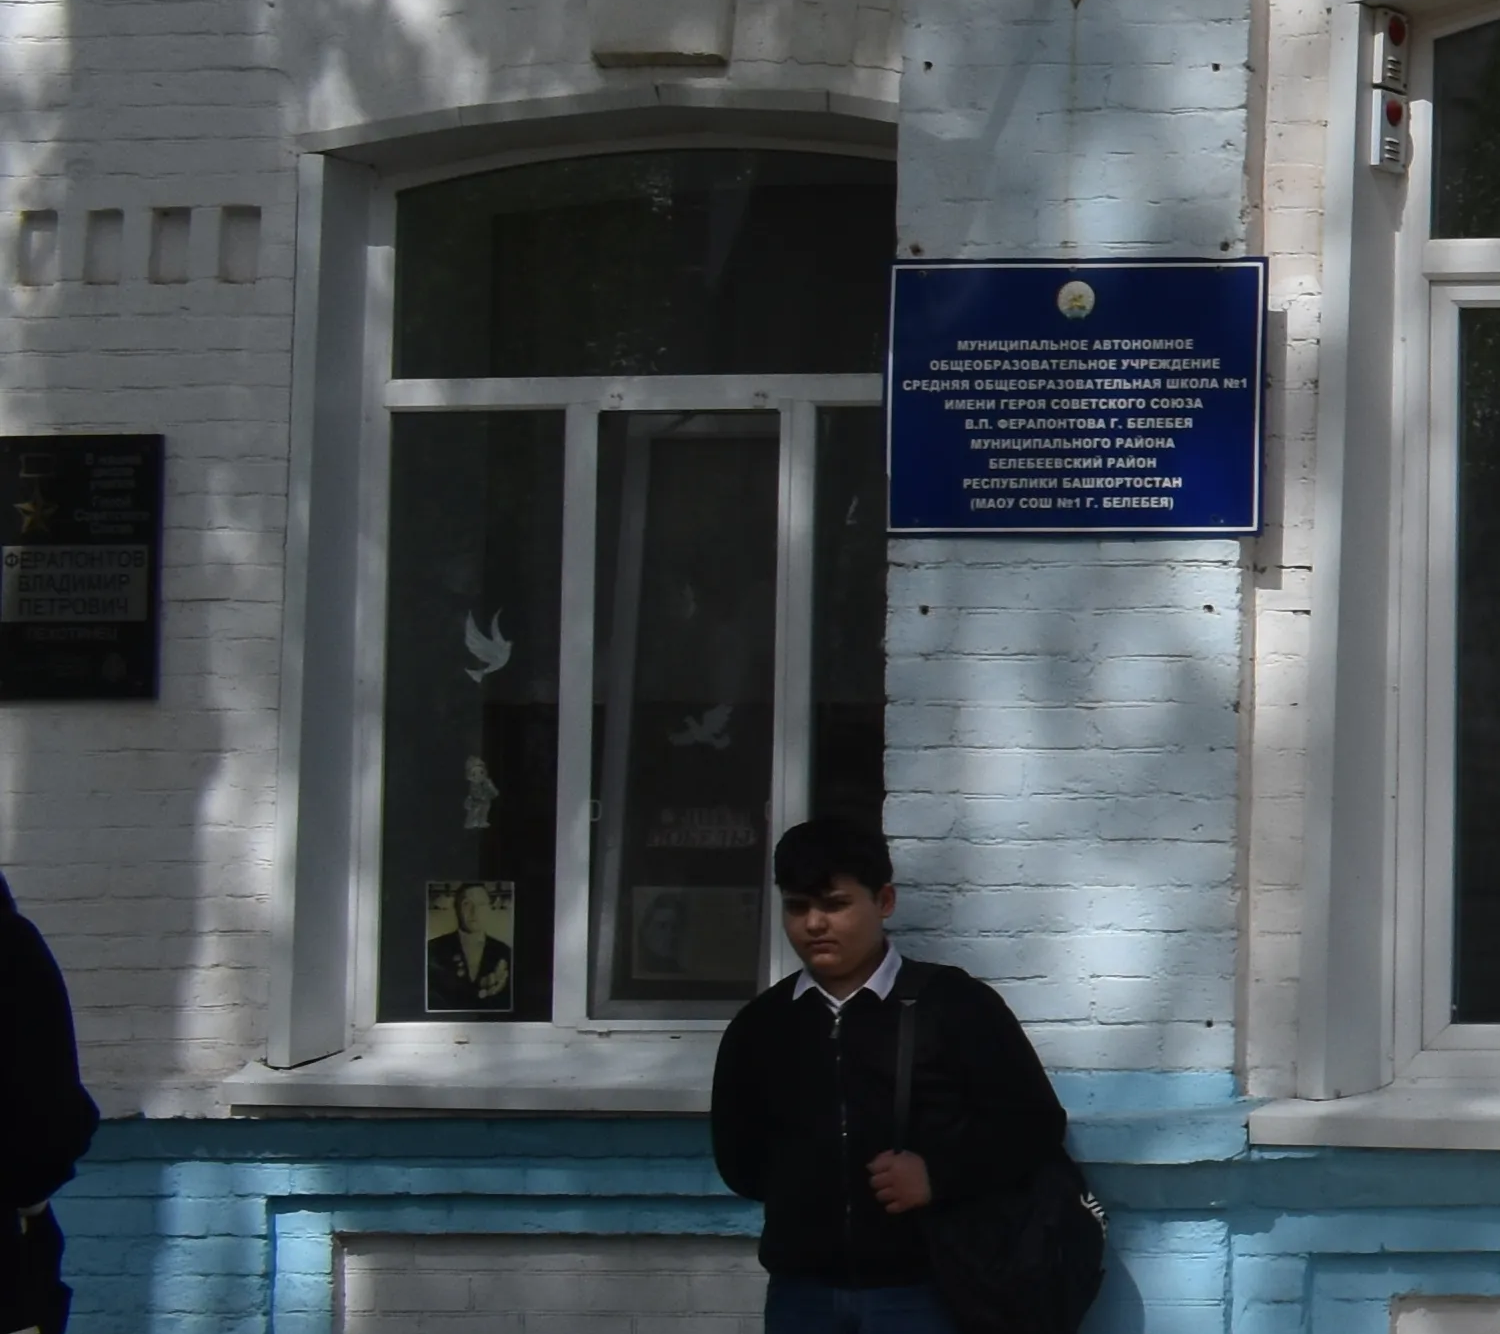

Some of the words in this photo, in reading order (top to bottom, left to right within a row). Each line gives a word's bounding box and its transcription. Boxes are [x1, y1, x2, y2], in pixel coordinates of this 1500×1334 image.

[957, 340, 1088, 351] МУНИЦИПАЛЬНОЕ
[1093, 339, 1193, 350] АВТОНОМНОЕ
[930, 359, 1117, 371] ОБЩЕОБРАЗОВАТЕЛЬНОЕ
[1122, 359, 1220, 370] УЧРЕЖДЕНИЕ
[903, 379, 969, 392] СРЕДНЯЯ
[974, 379, 1161, 391] ОБЩЕОБРАЗОВАТЕЛЬНАЯ
[1166, 379, 1219, 389] ШКОЛА
[1224, 379, 1247, 389] №1
[944, 399, 996, 410] ИМЕНИ
[1001, 399, 1046, 410] ГЕРОЯ
[1051, 399, 1146, 409] СОВЕТСКОГО
[1151, 398, 1202, 409] СОЮЗА
[965, 419, 992, 429] В.П.
[998, 419, 1105, 429] ФЕРАПОНТОВА
[1110, 419, 1122, 429] Г.
[1127, 418, 1192, 429] БЕЛЕБЕЯ
[971, 438, 1111, 450] МУНИЦИПАЛЬНОГО
[1116, 436, 1175, 448] РАЙОНА
[989, 457, 1102, 469] БЕЛЕБЕЕВСКИЙ
[1107, 456, 1156, 468] РАЙОН
[963, 478, 1057, 489] РЕСПУБЛИКИ
[1062, 477, 1182, 488] БАШКОРТОСТАН
[970, 498, 1014, 510] (МАОУ
[1019, 498, 1052, 509] СОШ
[1057, 498, 1081, 508] №1
[1086, 498, 1098, 508] Г.
[1103, 497, 1173, 509] БЕЛЕБЕЯ)
[4, 551, 146, 568] ФЕРАПОНТОВ
[19, 574, 130, 595] ВЛАДИМИР
[19, 597, 128, 615] ПЕТРОВИЧ
